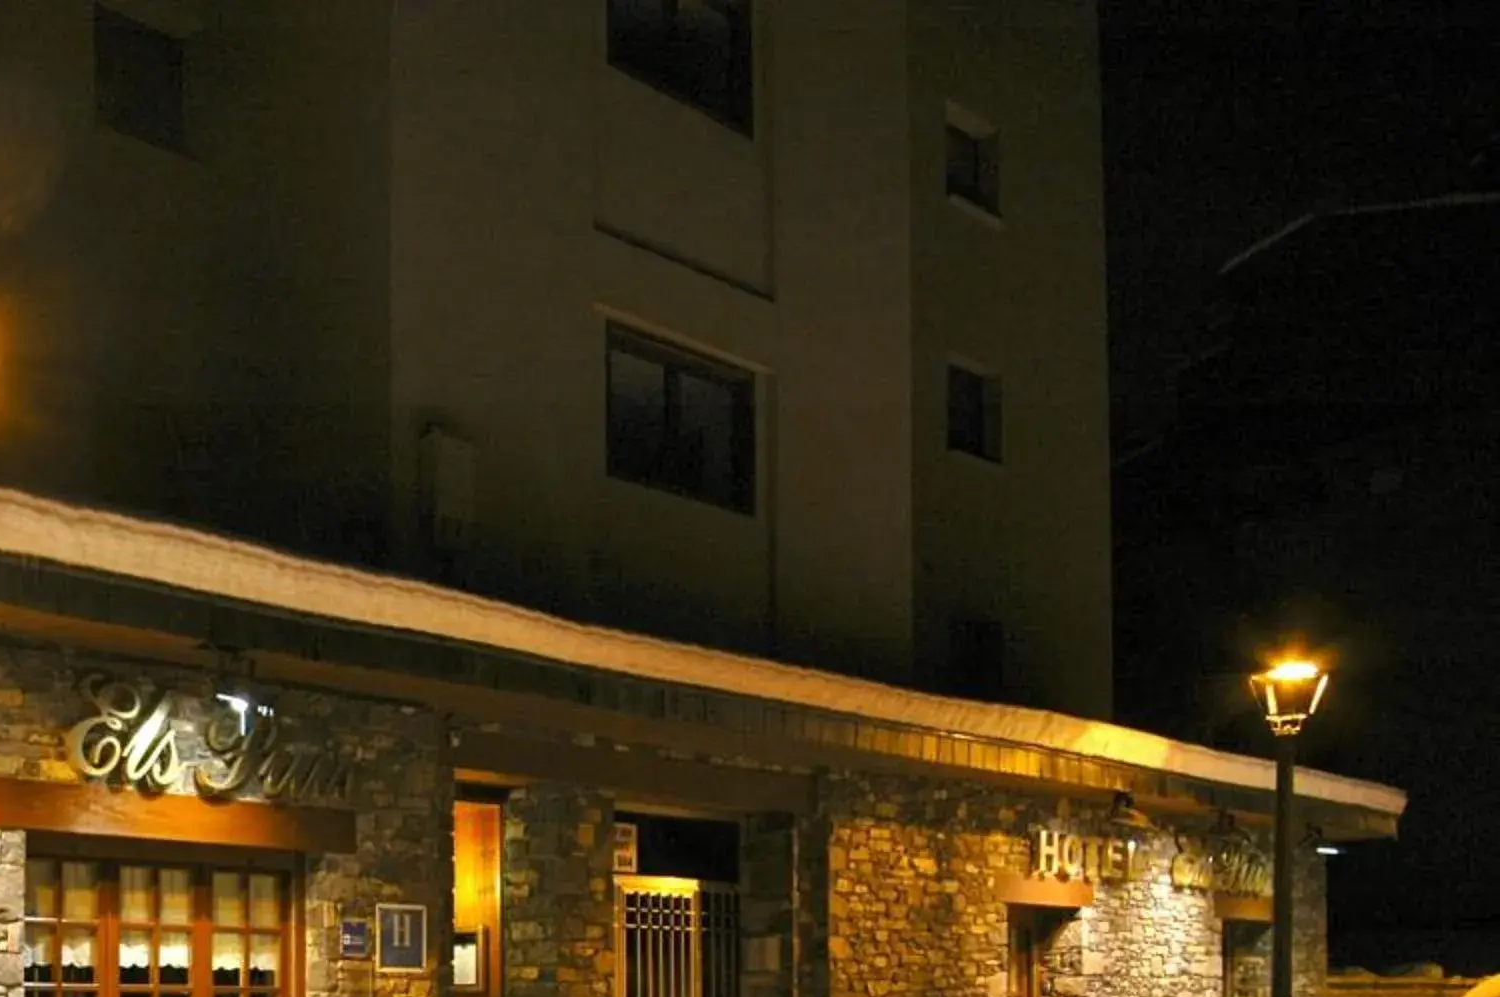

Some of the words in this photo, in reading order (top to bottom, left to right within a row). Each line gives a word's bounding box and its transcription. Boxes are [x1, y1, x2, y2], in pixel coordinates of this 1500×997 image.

[64, 672, 188, 787] Els
[1039, 828, 1146, 880] HOTEL
[392, 912, 412, 948] H
